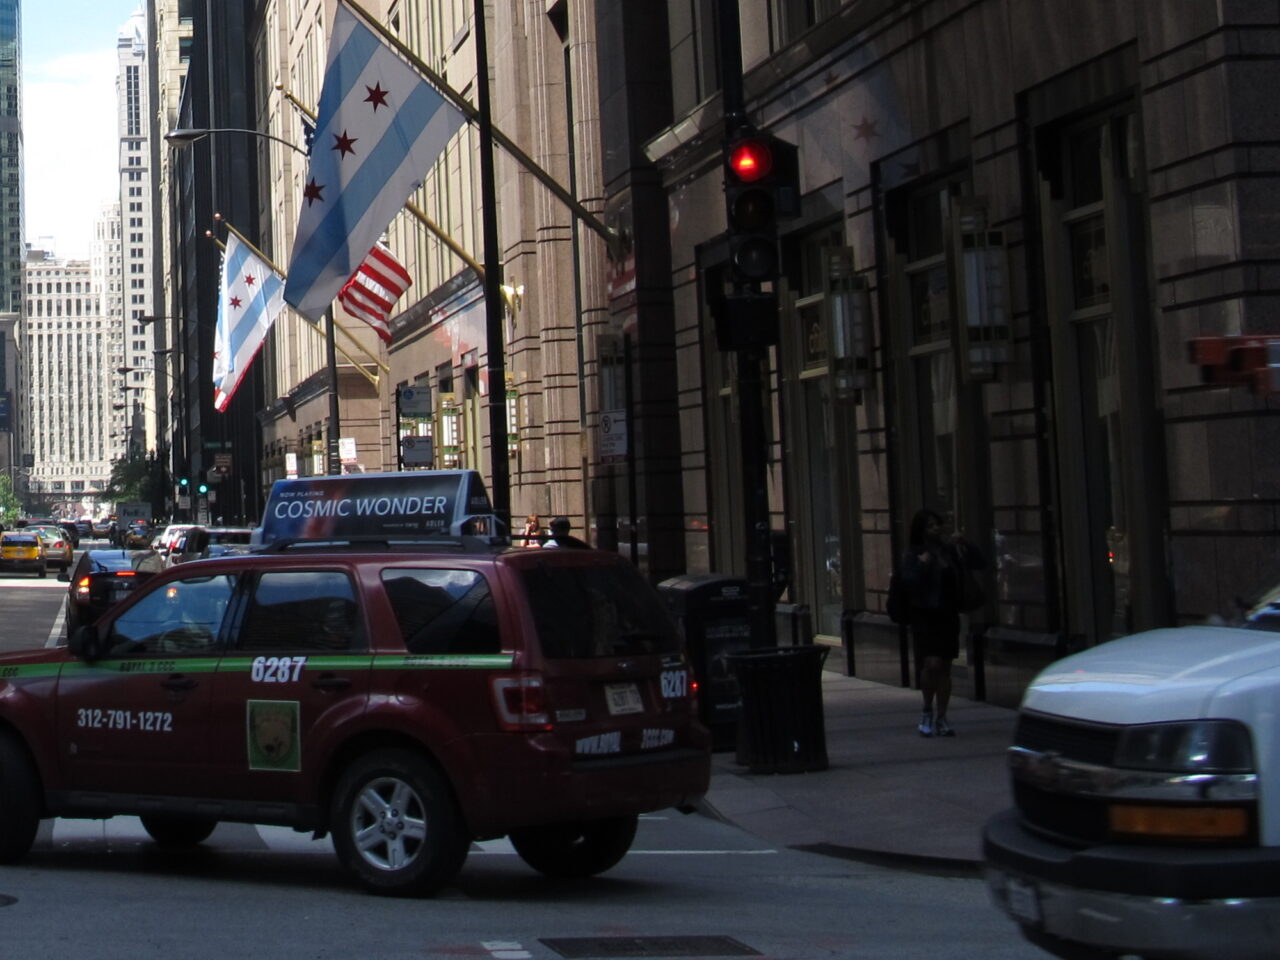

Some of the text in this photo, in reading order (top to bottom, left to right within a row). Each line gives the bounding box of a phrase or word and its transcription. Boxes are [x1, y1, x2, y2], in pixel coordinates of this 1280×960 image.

[274, 496, 447, 520] COSMIC WONDER
[250, 656, 308, 683] 6287
[660, 670, 687, 699] 6287
[76, 708, 174, 732] 312-791-1272
